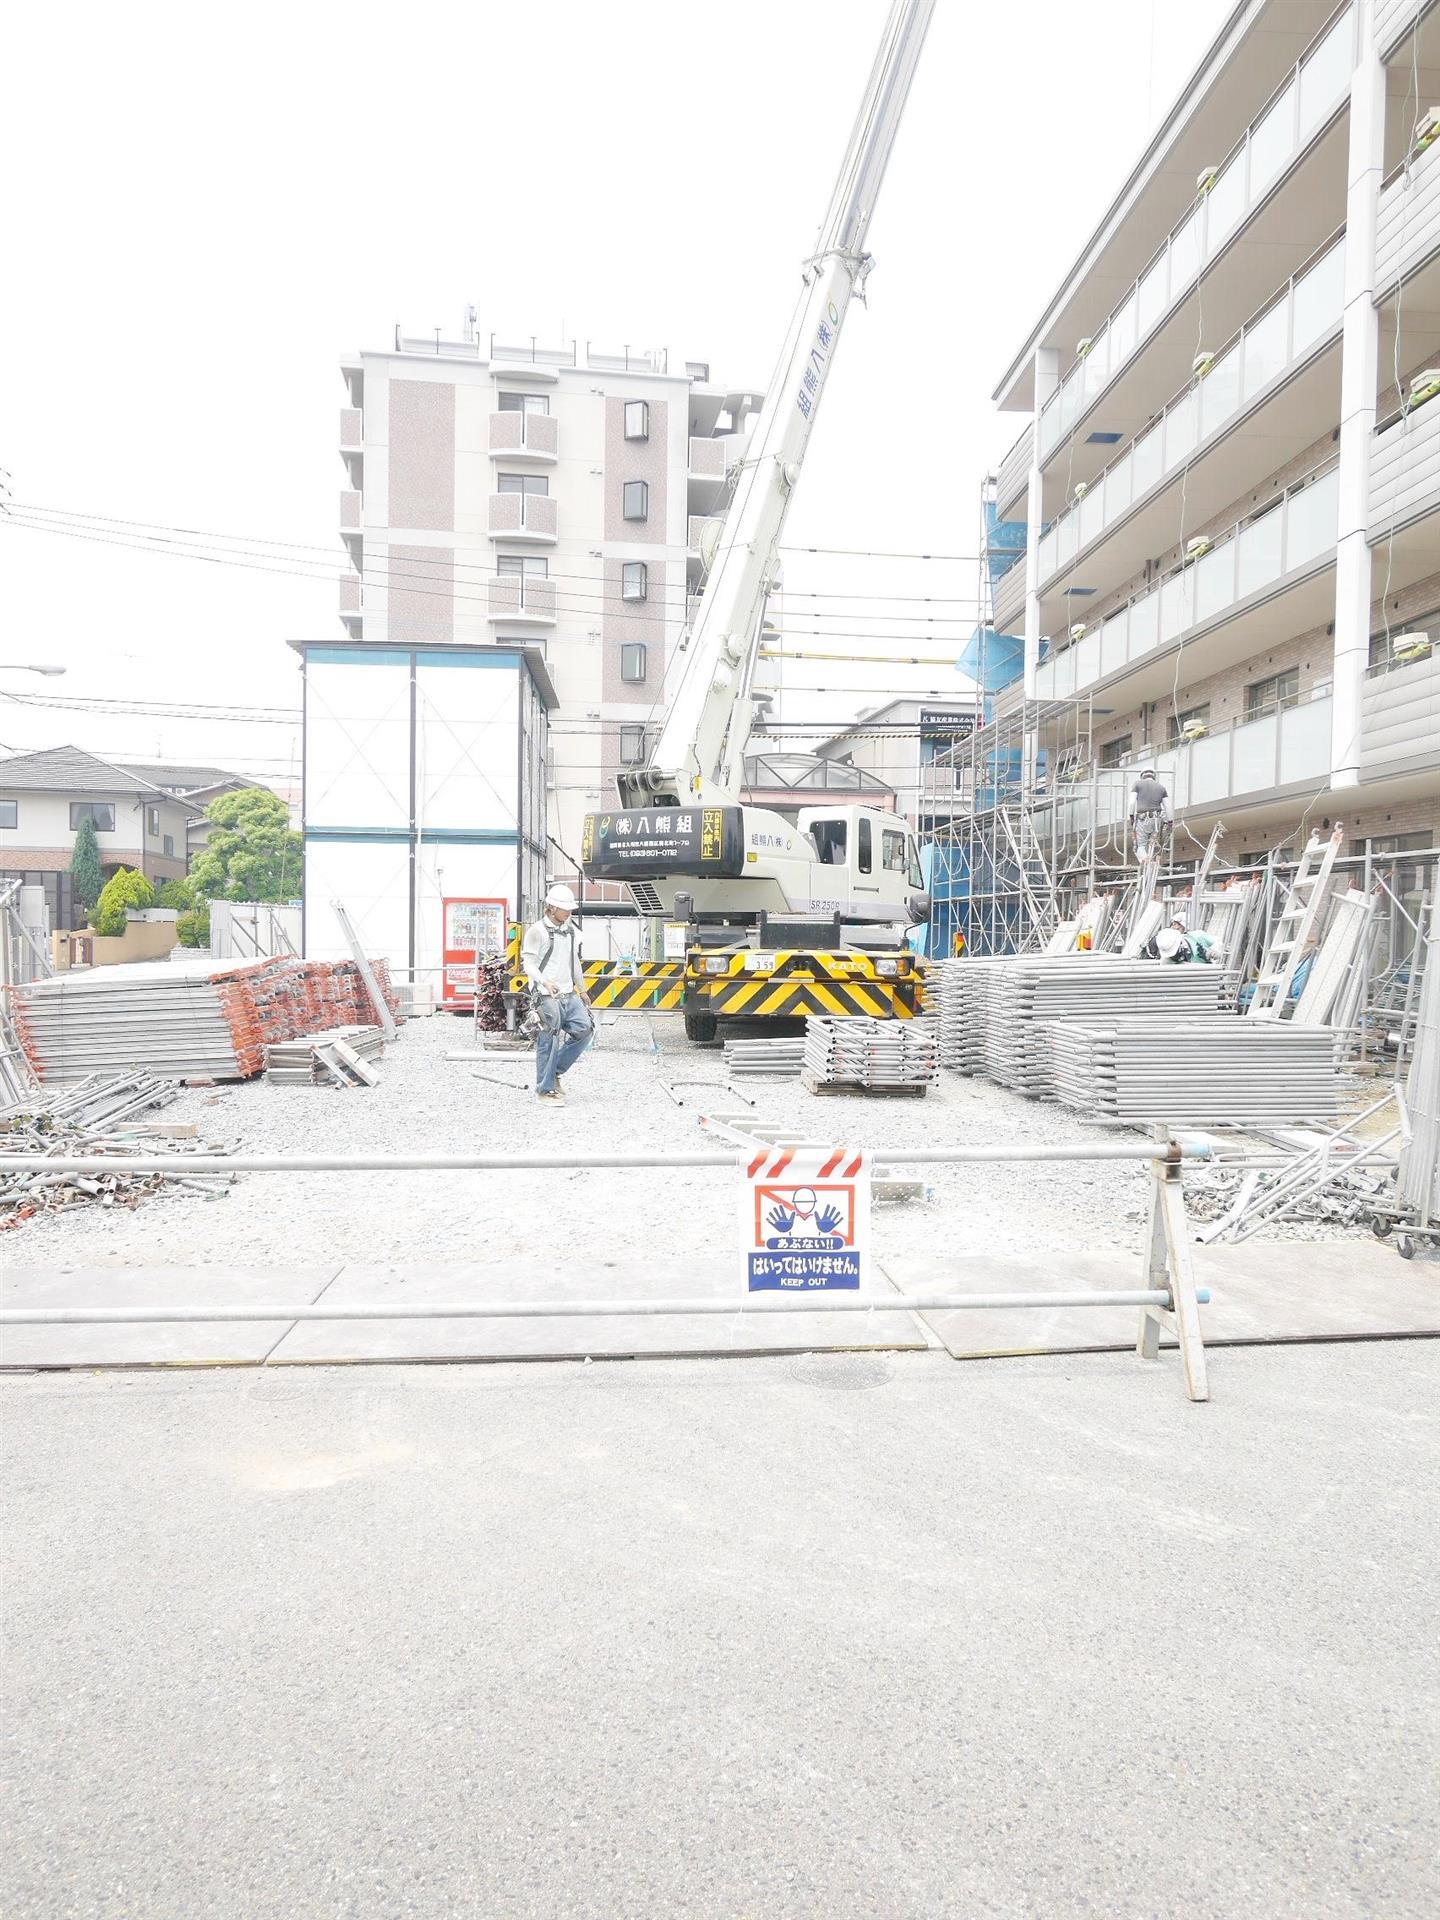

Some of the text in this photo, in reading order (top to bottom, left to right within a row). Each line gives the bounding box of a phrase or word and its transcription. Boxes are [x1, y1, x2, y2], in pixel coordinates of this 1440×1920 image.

[828, 961, 867, 973] KATO
[753, 1256, 858, 1275] はいってはいけません。
[780, 1278, 828, 1287] KEEP OUT
